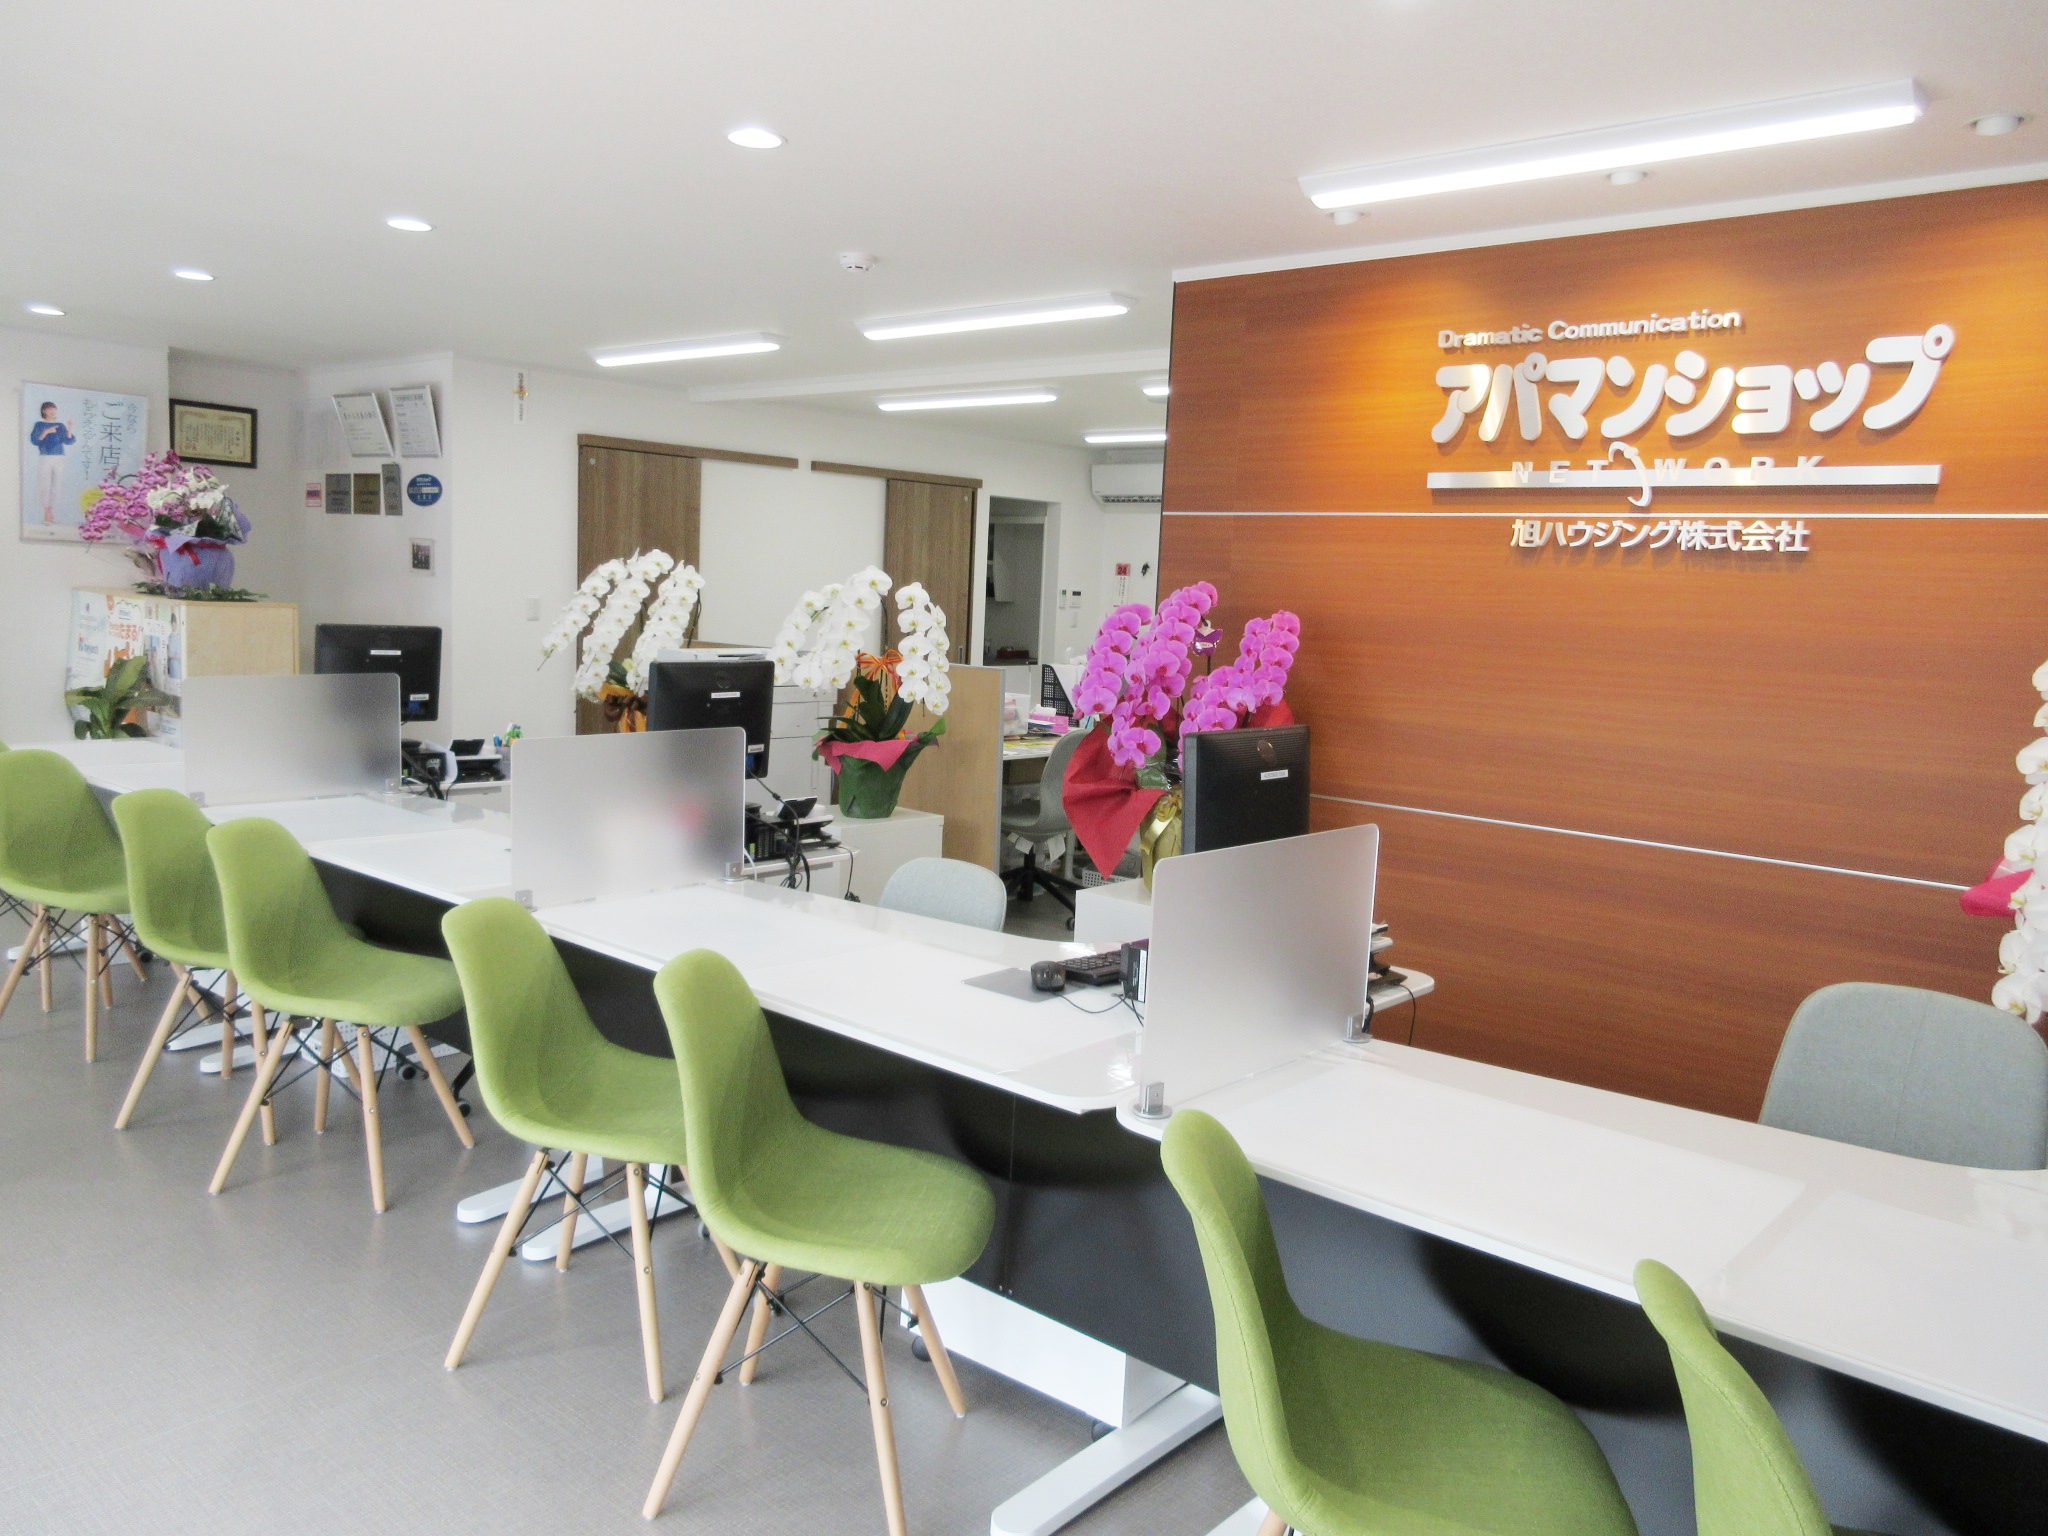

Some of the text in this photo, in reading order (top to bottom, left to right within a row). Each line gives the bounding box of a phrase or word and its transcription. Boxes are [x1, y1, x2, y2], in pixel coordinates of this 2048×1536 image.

[1437, 309, 1743, 348] Dramatic Communication
[1431, 323, 1955, 444] アパマンショップ
[1510, 518, 1811, 553] 旭ハウジング株式会社
